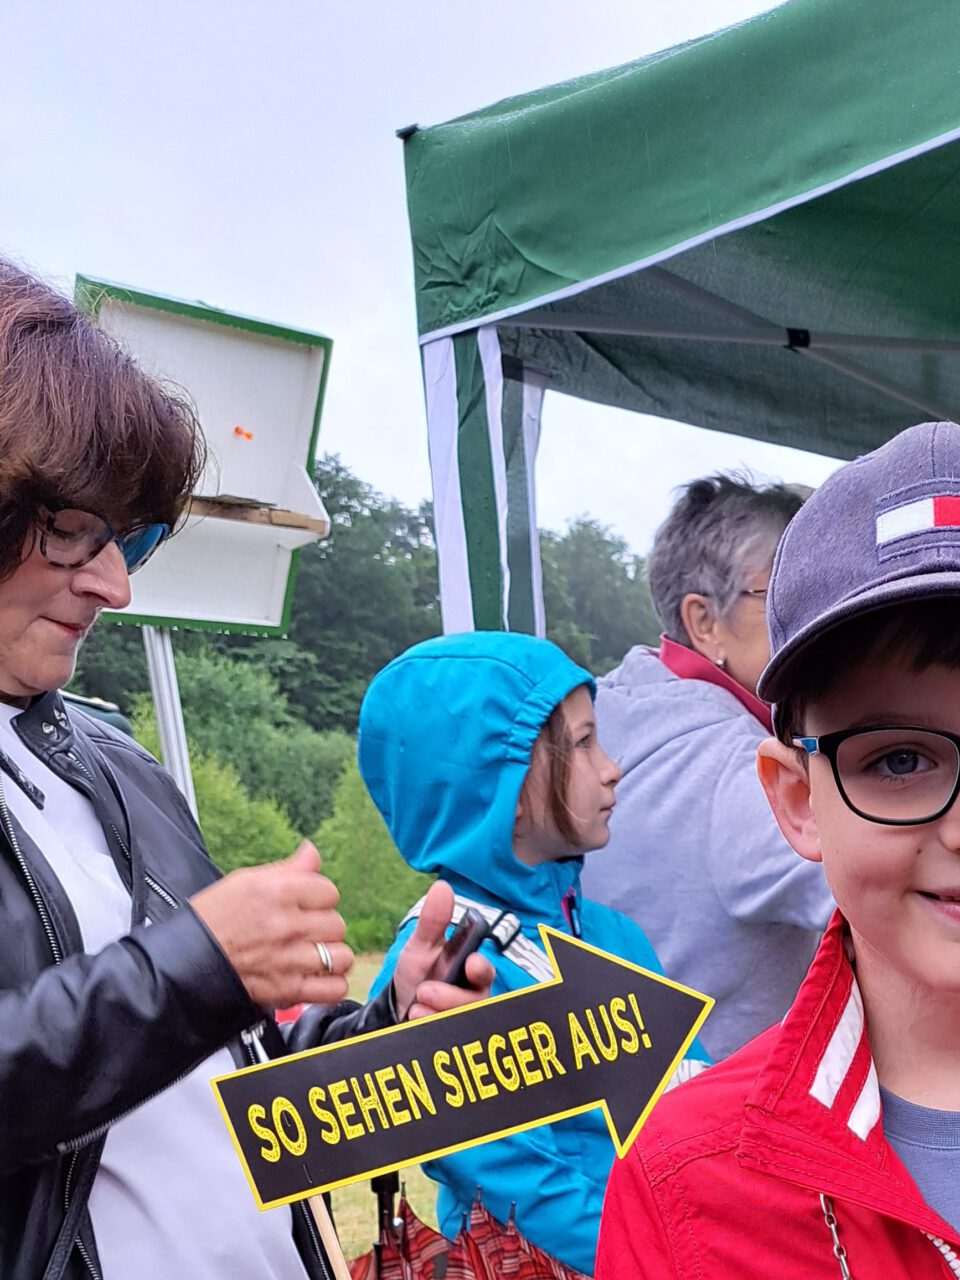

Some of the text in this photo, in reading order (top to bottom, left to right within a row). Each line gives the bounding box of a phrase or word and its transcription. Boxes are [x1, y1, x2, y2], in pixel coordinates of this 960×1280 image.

[247, 992, 653, 1163] SO SEHEN SIEGER AUS!
